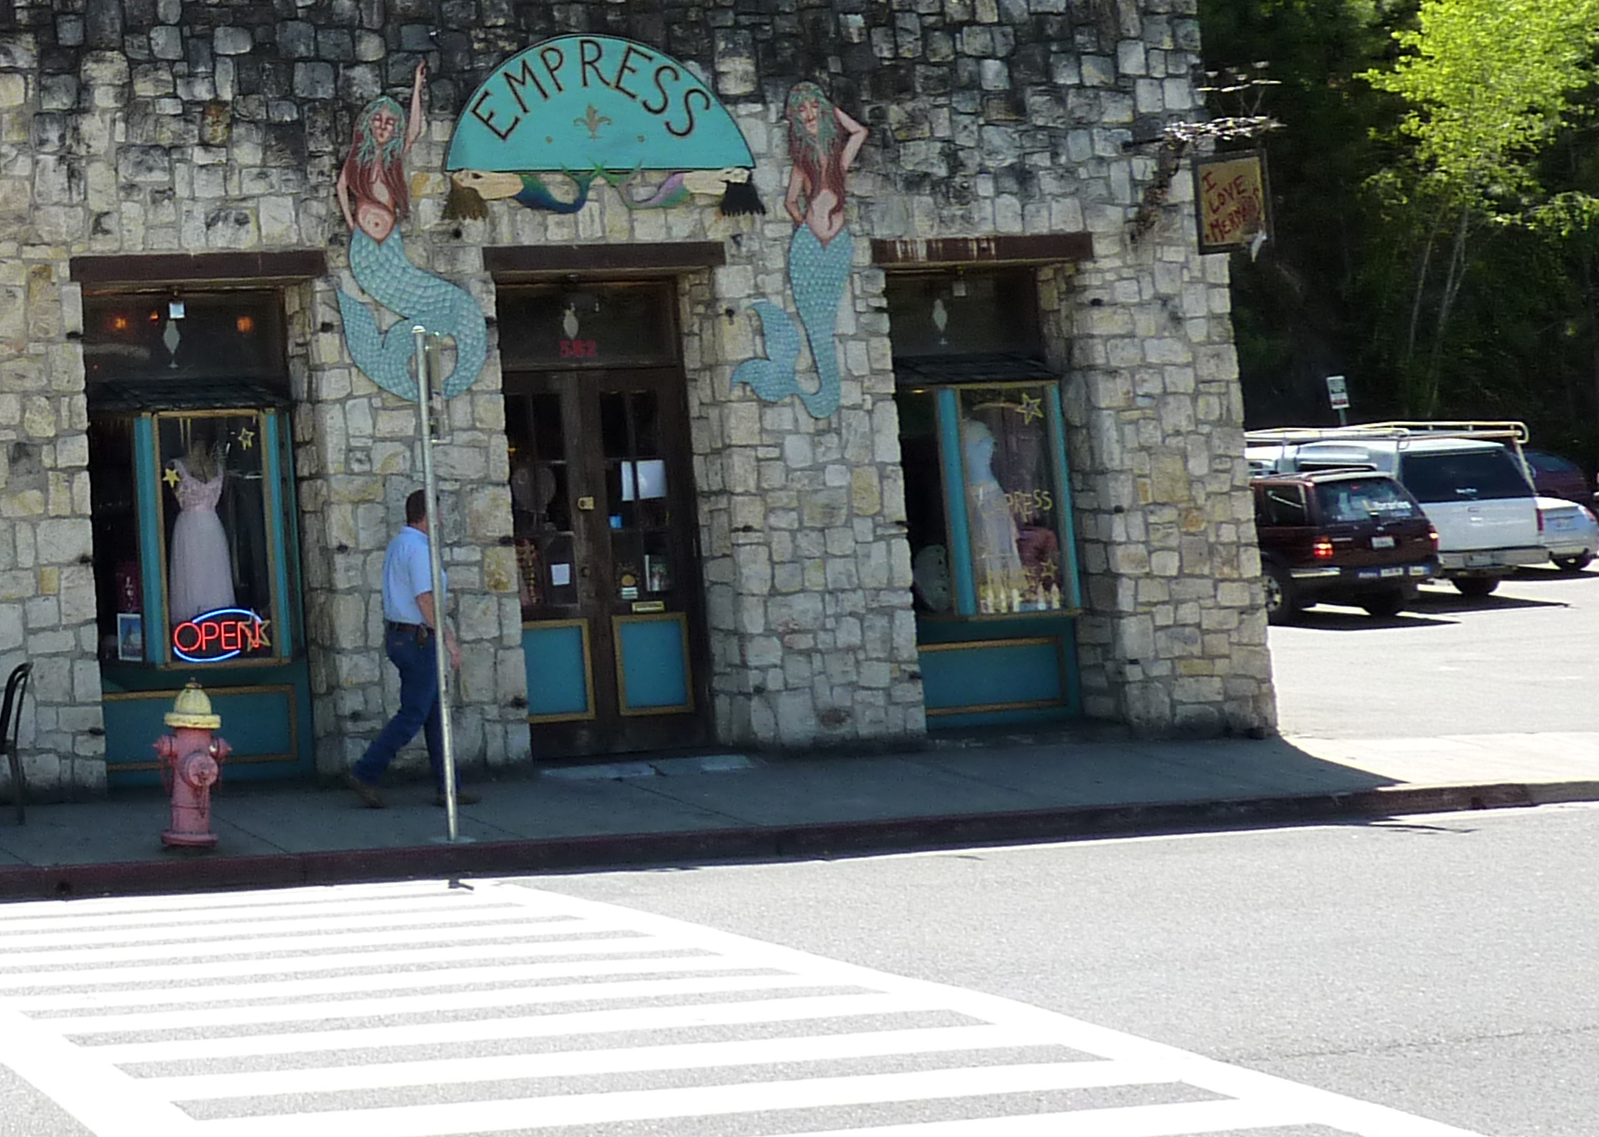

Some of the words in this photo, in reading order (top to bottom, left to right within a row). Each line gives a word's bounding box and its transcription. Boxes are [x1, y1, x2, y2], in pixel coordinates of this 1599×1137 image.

[470, 38, 712, 141] EMPRESS
[1202, 171, 1217, 194] I
[1209, 175, 1247, 214] LOVE
[978, 488, 1053, 521] PRESS
[174, 620, 263, 651] OPEN
